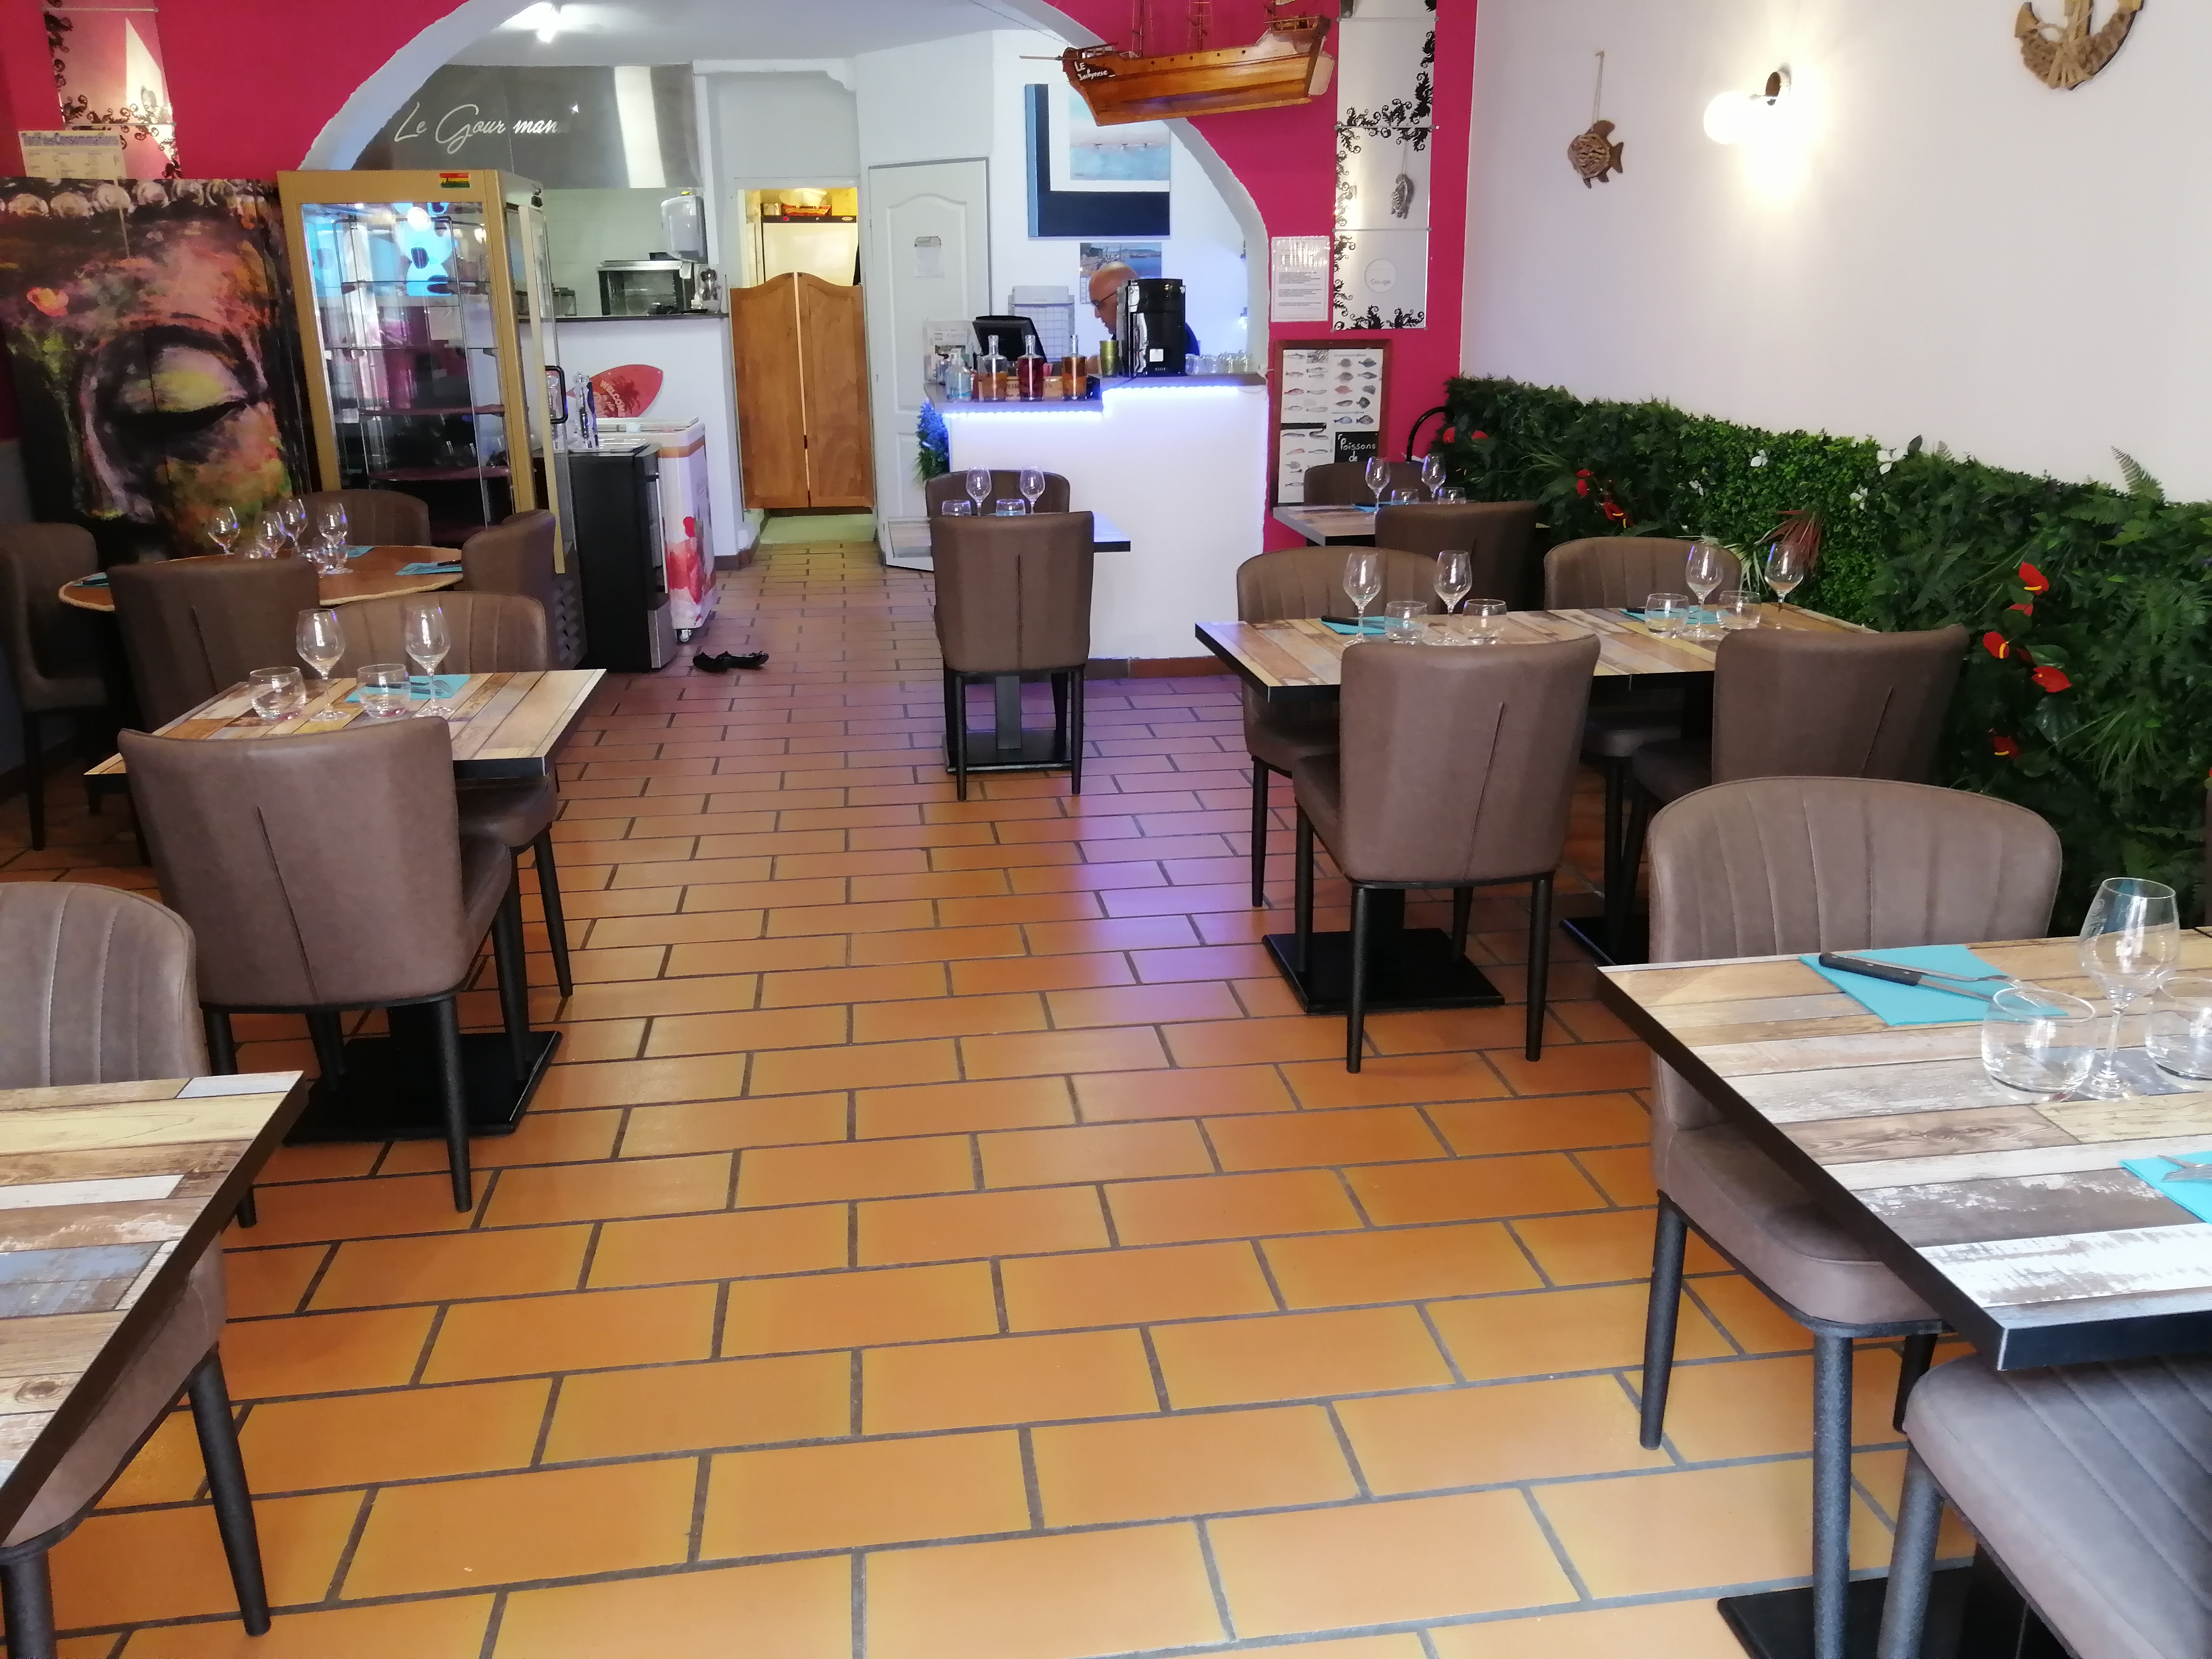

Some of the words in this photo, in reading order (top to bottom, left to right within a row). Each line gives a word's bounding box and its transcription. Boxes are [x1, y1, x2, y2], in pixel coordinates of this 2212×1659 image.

[1074, 61, 1086, 72] LE
[394, 101, 427, 142] Le
[435, 104, 505, 154] Gour
[1340, 437, 1376, 450] Poissons
[1348, 450, 1358, 462] de
